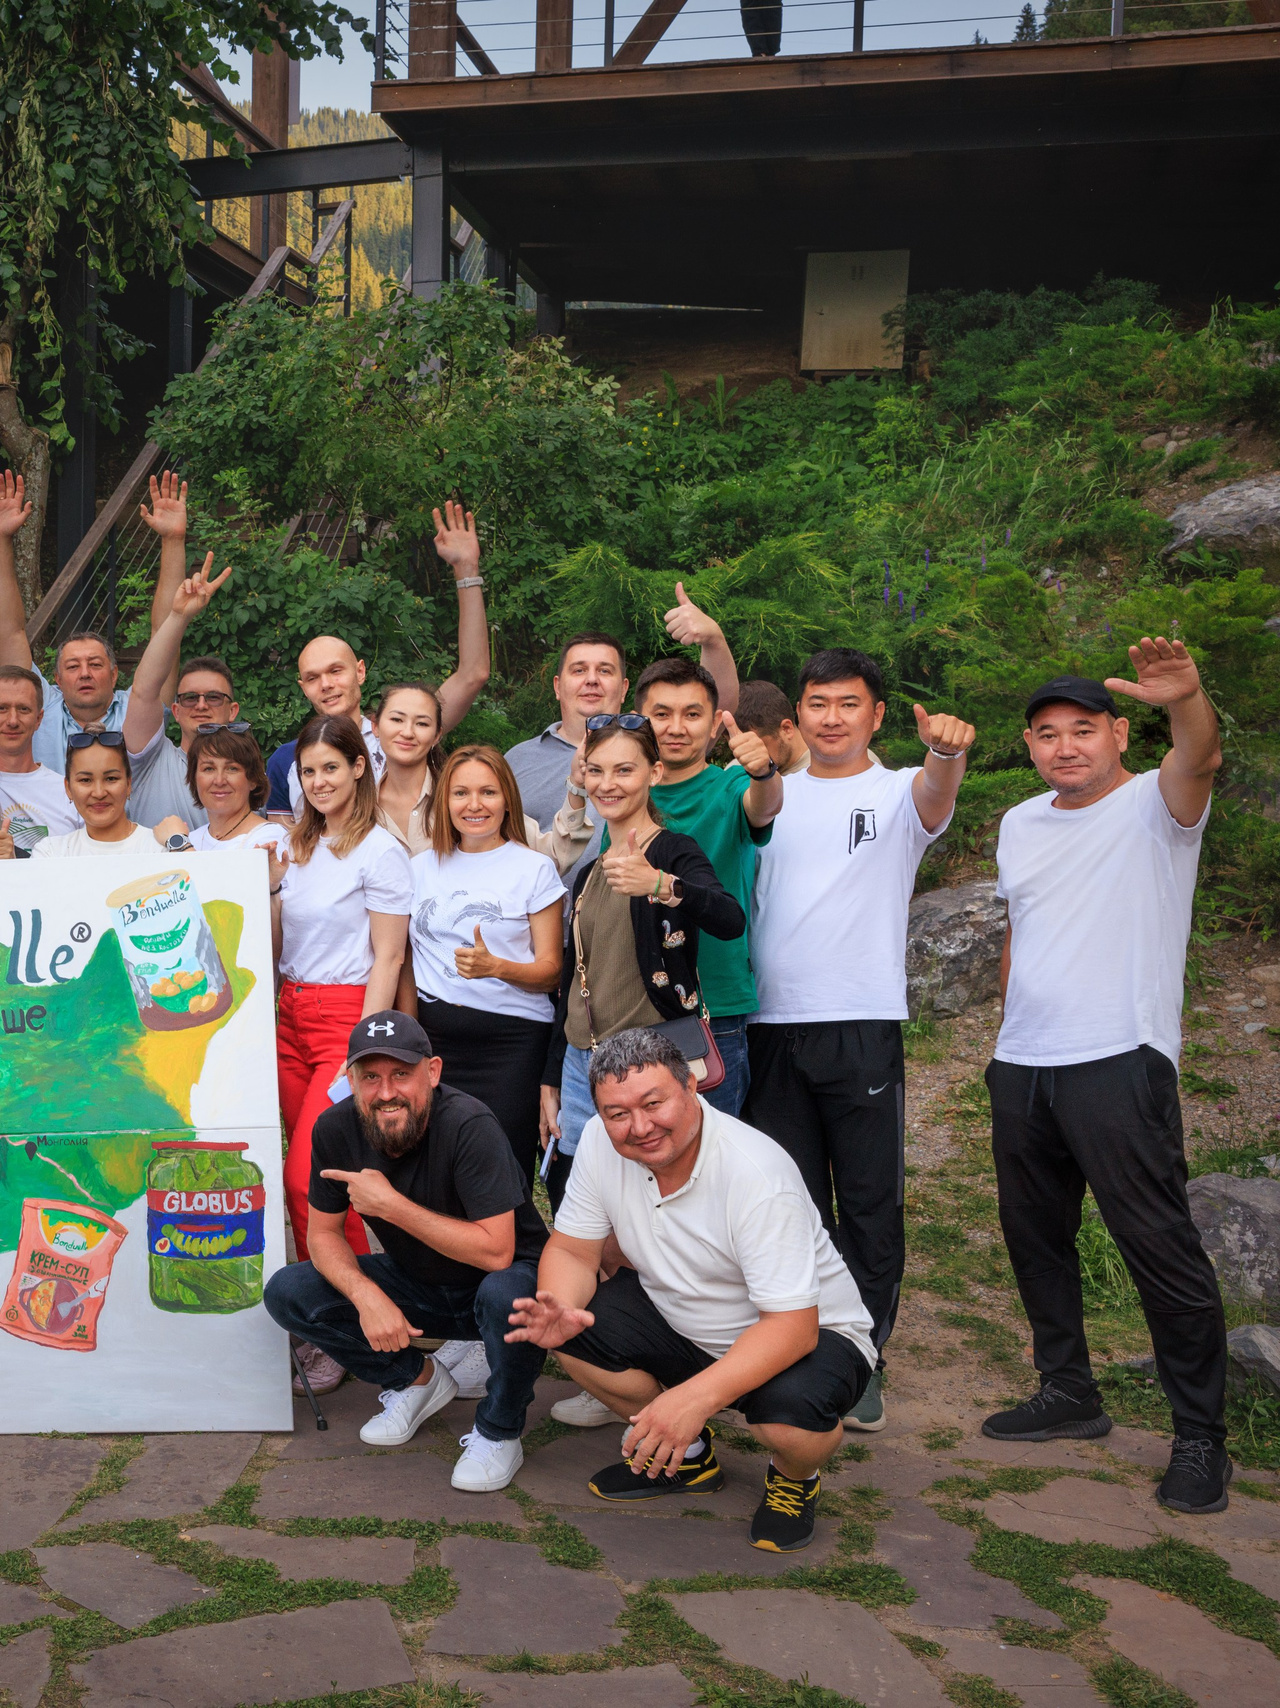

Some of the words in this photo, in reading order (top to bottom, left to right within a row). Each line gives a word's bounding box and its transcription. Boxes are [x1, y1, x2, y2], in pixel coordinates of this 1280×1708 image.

[118, 890, 186, 927] Bonduelle
[36, 1135, 88, 1147] Монголия
[163, 1190, 253, 1214] GLOBUS
[30, 1250, 90, 1278] КРЕМ-СУП
